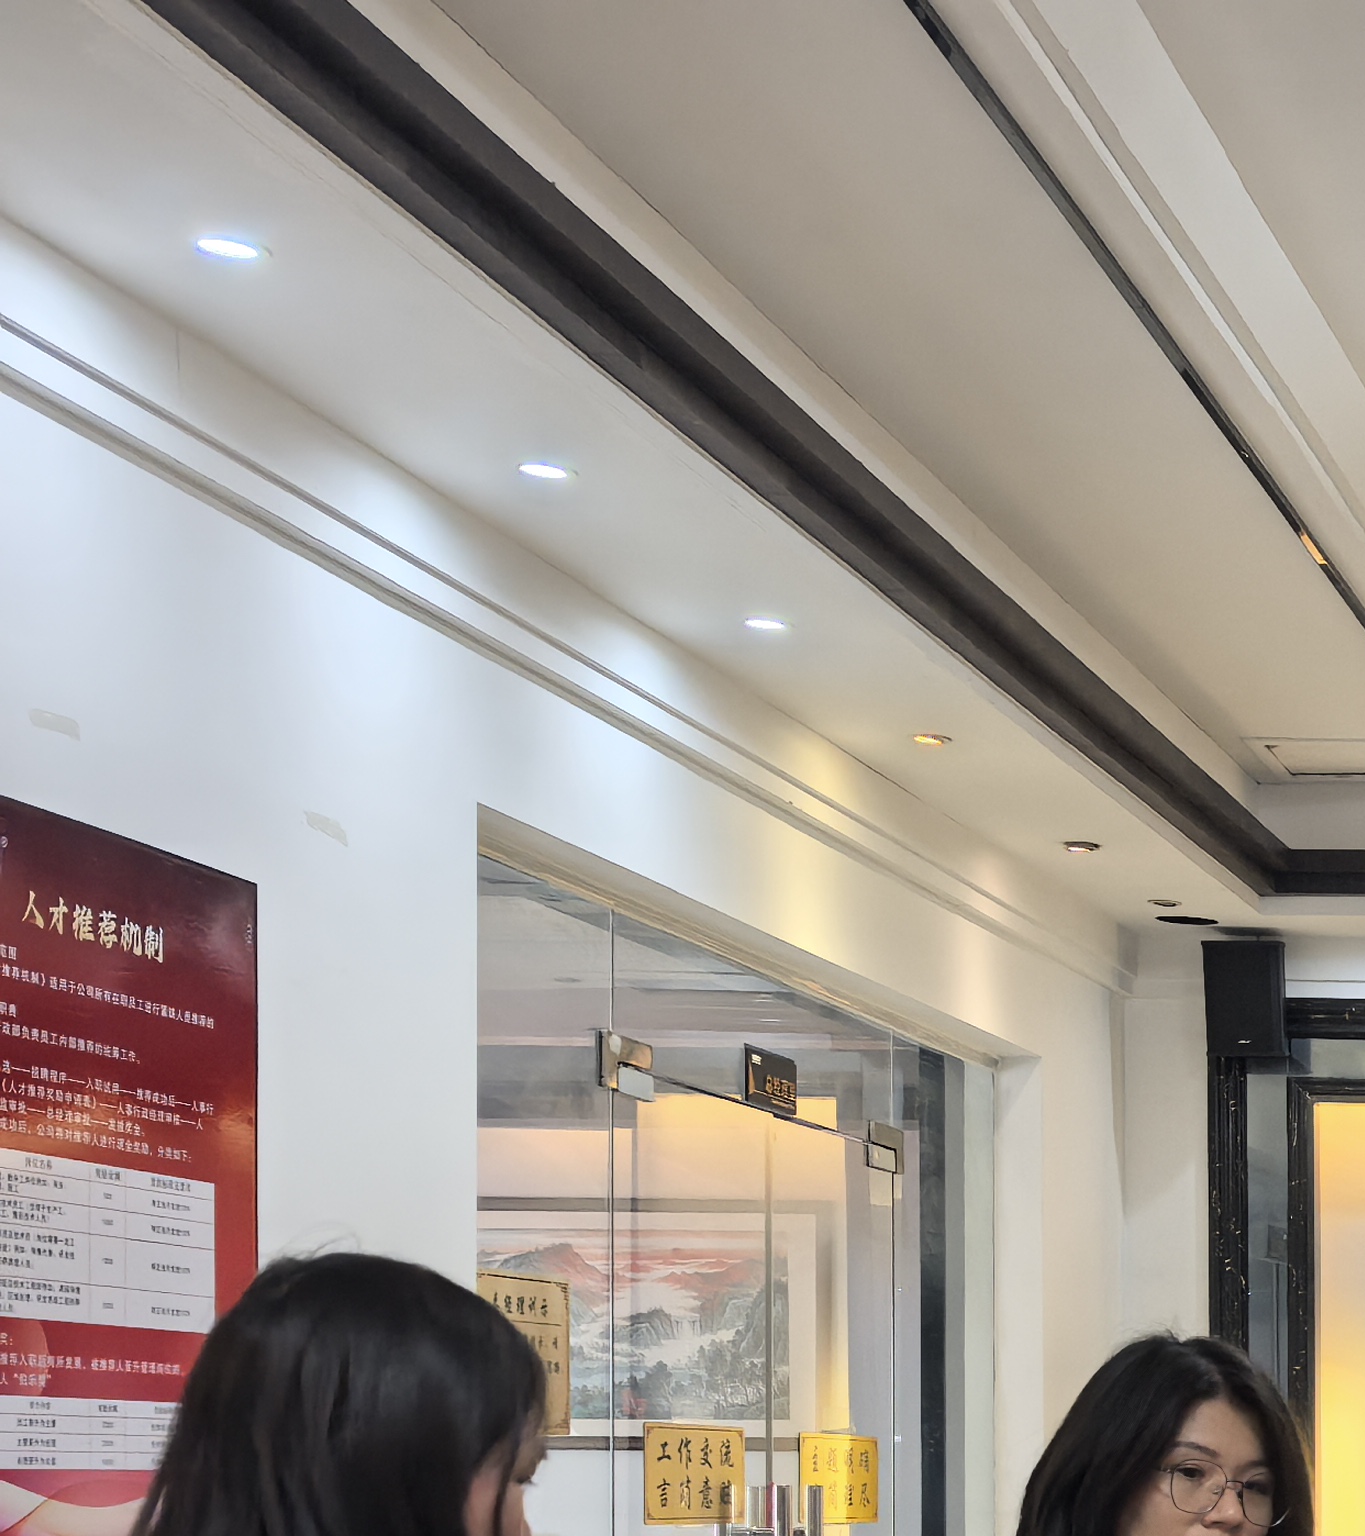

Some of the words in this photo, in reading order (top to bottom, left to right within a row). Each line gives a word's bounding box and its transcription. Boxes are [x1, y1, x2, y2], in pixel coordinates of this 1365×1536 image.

[22, 890, 165, 964] 人才推荐机制
[656, 1436, 735, 1470] 工作交流
